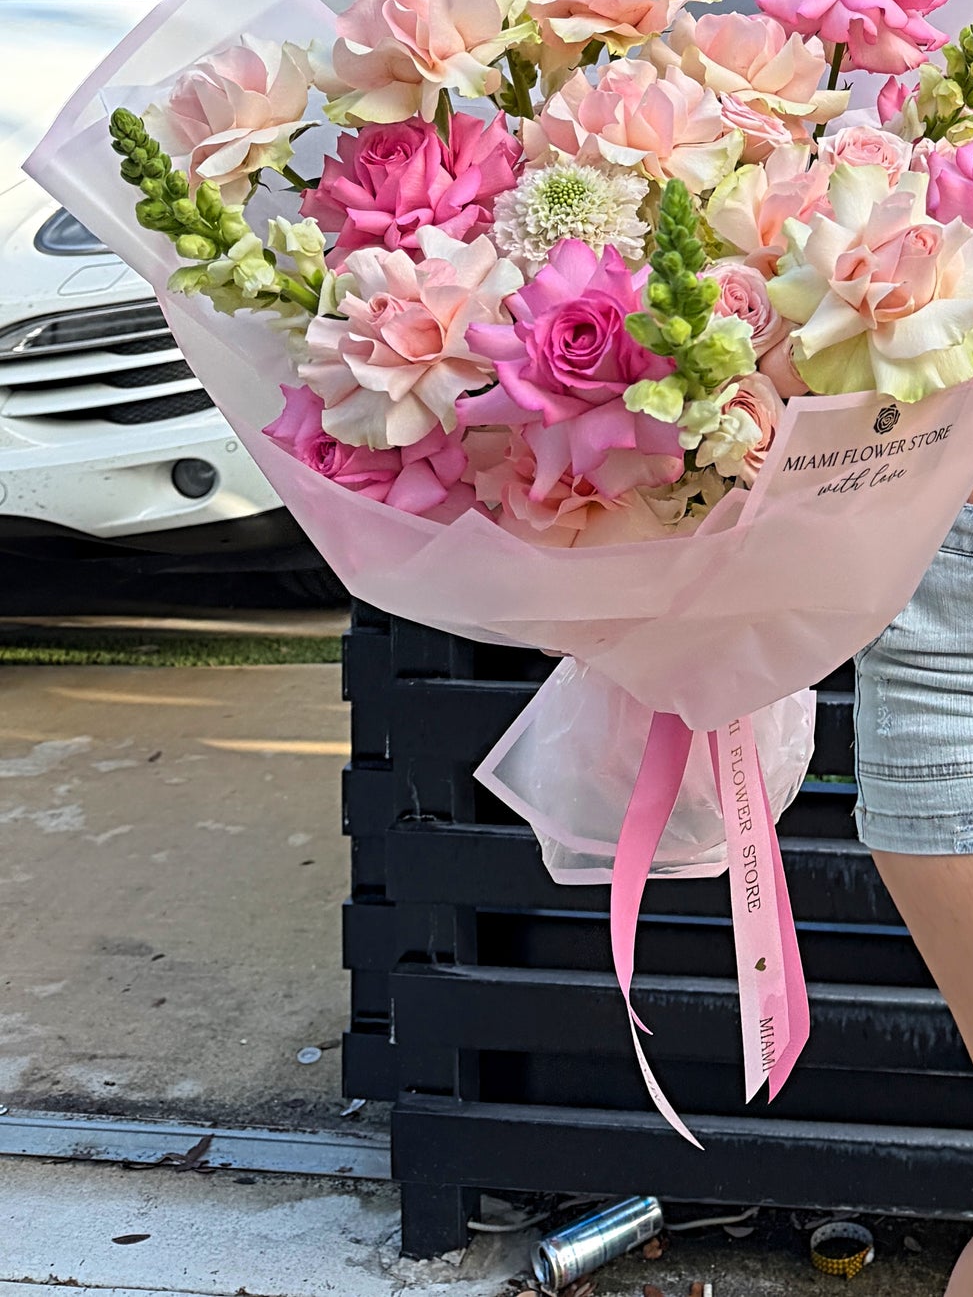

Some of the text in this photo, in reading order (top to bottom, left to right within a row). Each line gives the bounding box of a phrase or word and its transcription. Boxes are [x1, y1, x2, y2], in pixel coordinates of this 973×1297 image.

[783, 424, 953, 472] MIAMI FLOWER STORE
[817, 464, 908, 496] with love
[731, 745, 753, 835] FLOWER
[742, 844, 761, 914] STORE
[759, 1015, 777, 1073] MIAMI
